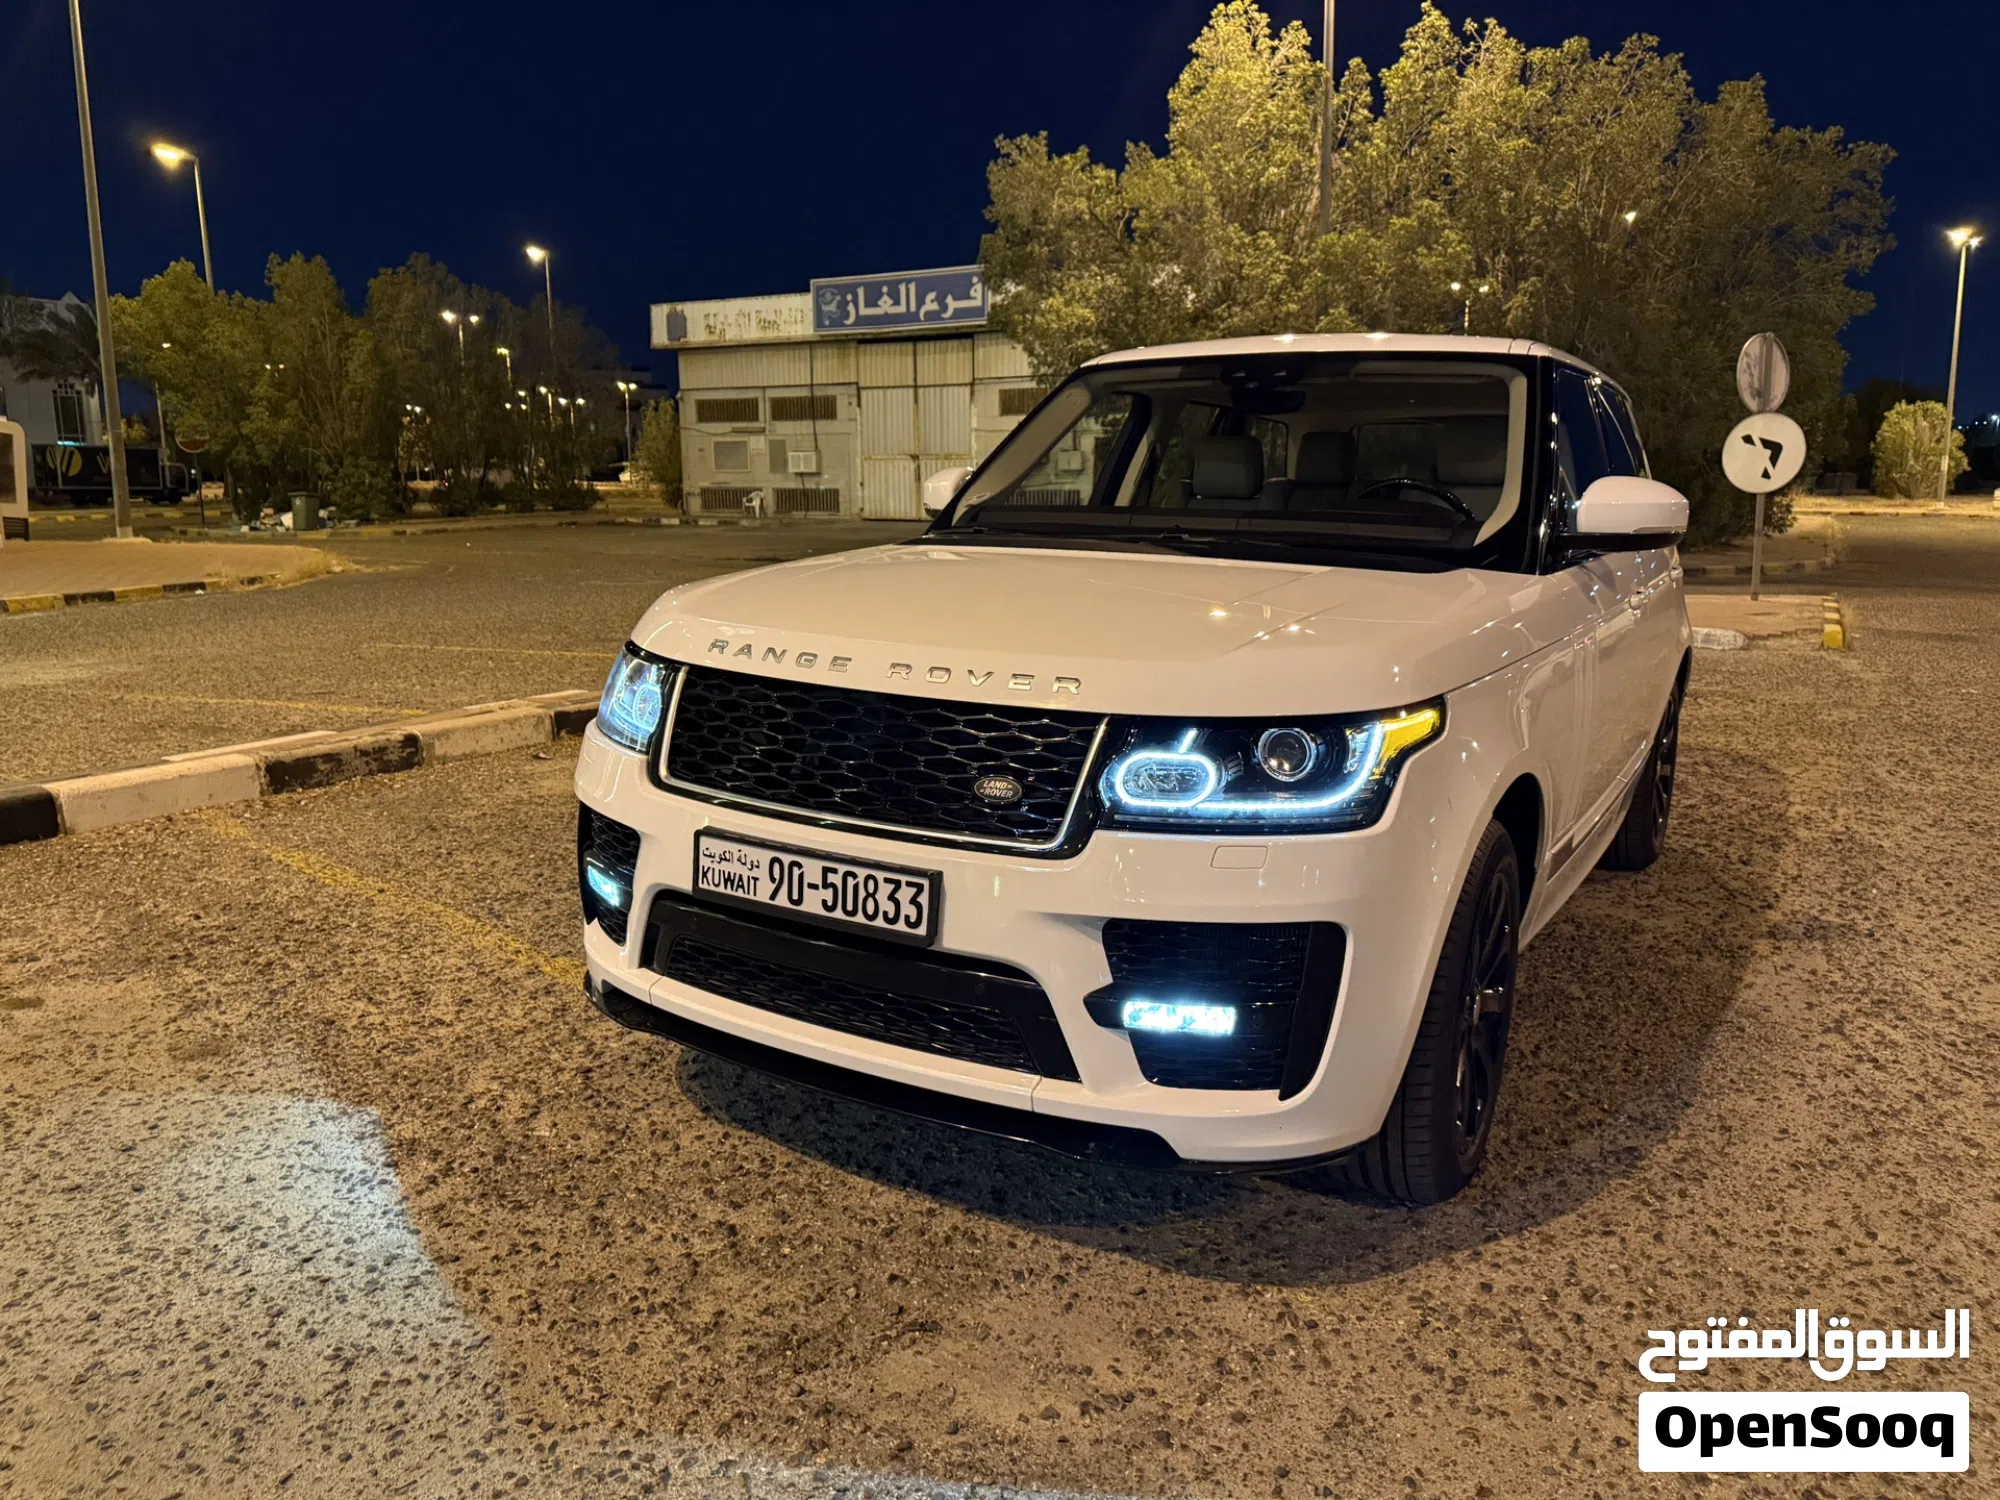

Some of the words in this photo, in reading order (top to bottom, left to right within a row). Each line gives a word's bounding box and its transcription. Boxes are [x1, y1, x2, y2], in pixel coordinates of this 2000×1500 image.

[843, 281, 917, 325] الغاز
[919, 275, 983, 322] فرع
[707, 638, 852, 673] RANGE
[886, 662, 1082, 695] ROVER
[983, 780, 1008, 789] LAND
[983, 788, 1013, 798] ROVER
[702, 846, 734, 865] الكويت
[736, 848, 760, 871] دولة
[701, 865, 760, 897] KUWAIT
[768, 856, 924, 929] 90-50833
